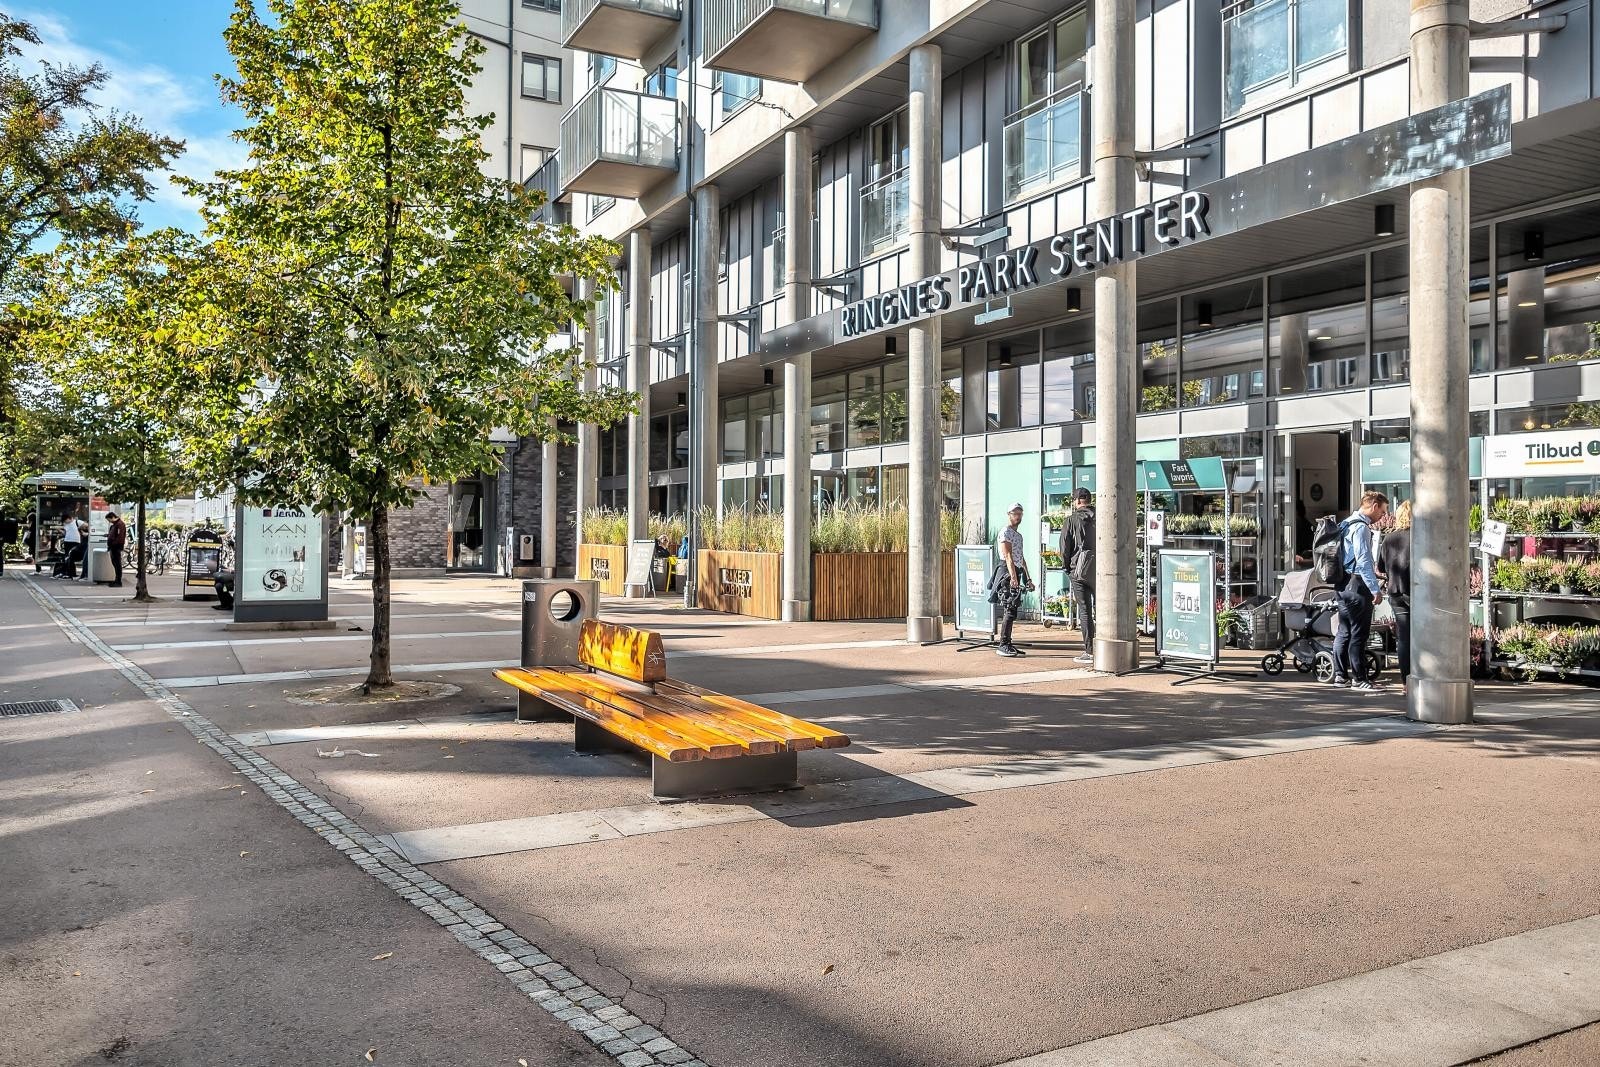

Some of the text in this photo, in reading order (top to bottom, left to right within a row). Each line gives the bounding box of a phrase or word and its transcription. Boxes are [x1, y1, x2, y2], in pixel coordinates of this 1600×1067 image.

[840, 190, 1212, 337] RINGNES PARK SENTER
[1524, 442, 1583, 459] Tilbud
[1171, 463, 1189, 472] Fast
[1170, 472, 1195, 484] lavpris
[262, 523, 307, 534] KAN
[1173, 571, 1200, 582] Tilbud
[720, 583, 752, 599] NORDBY
[1165, 628, 1189, 642] 40%
